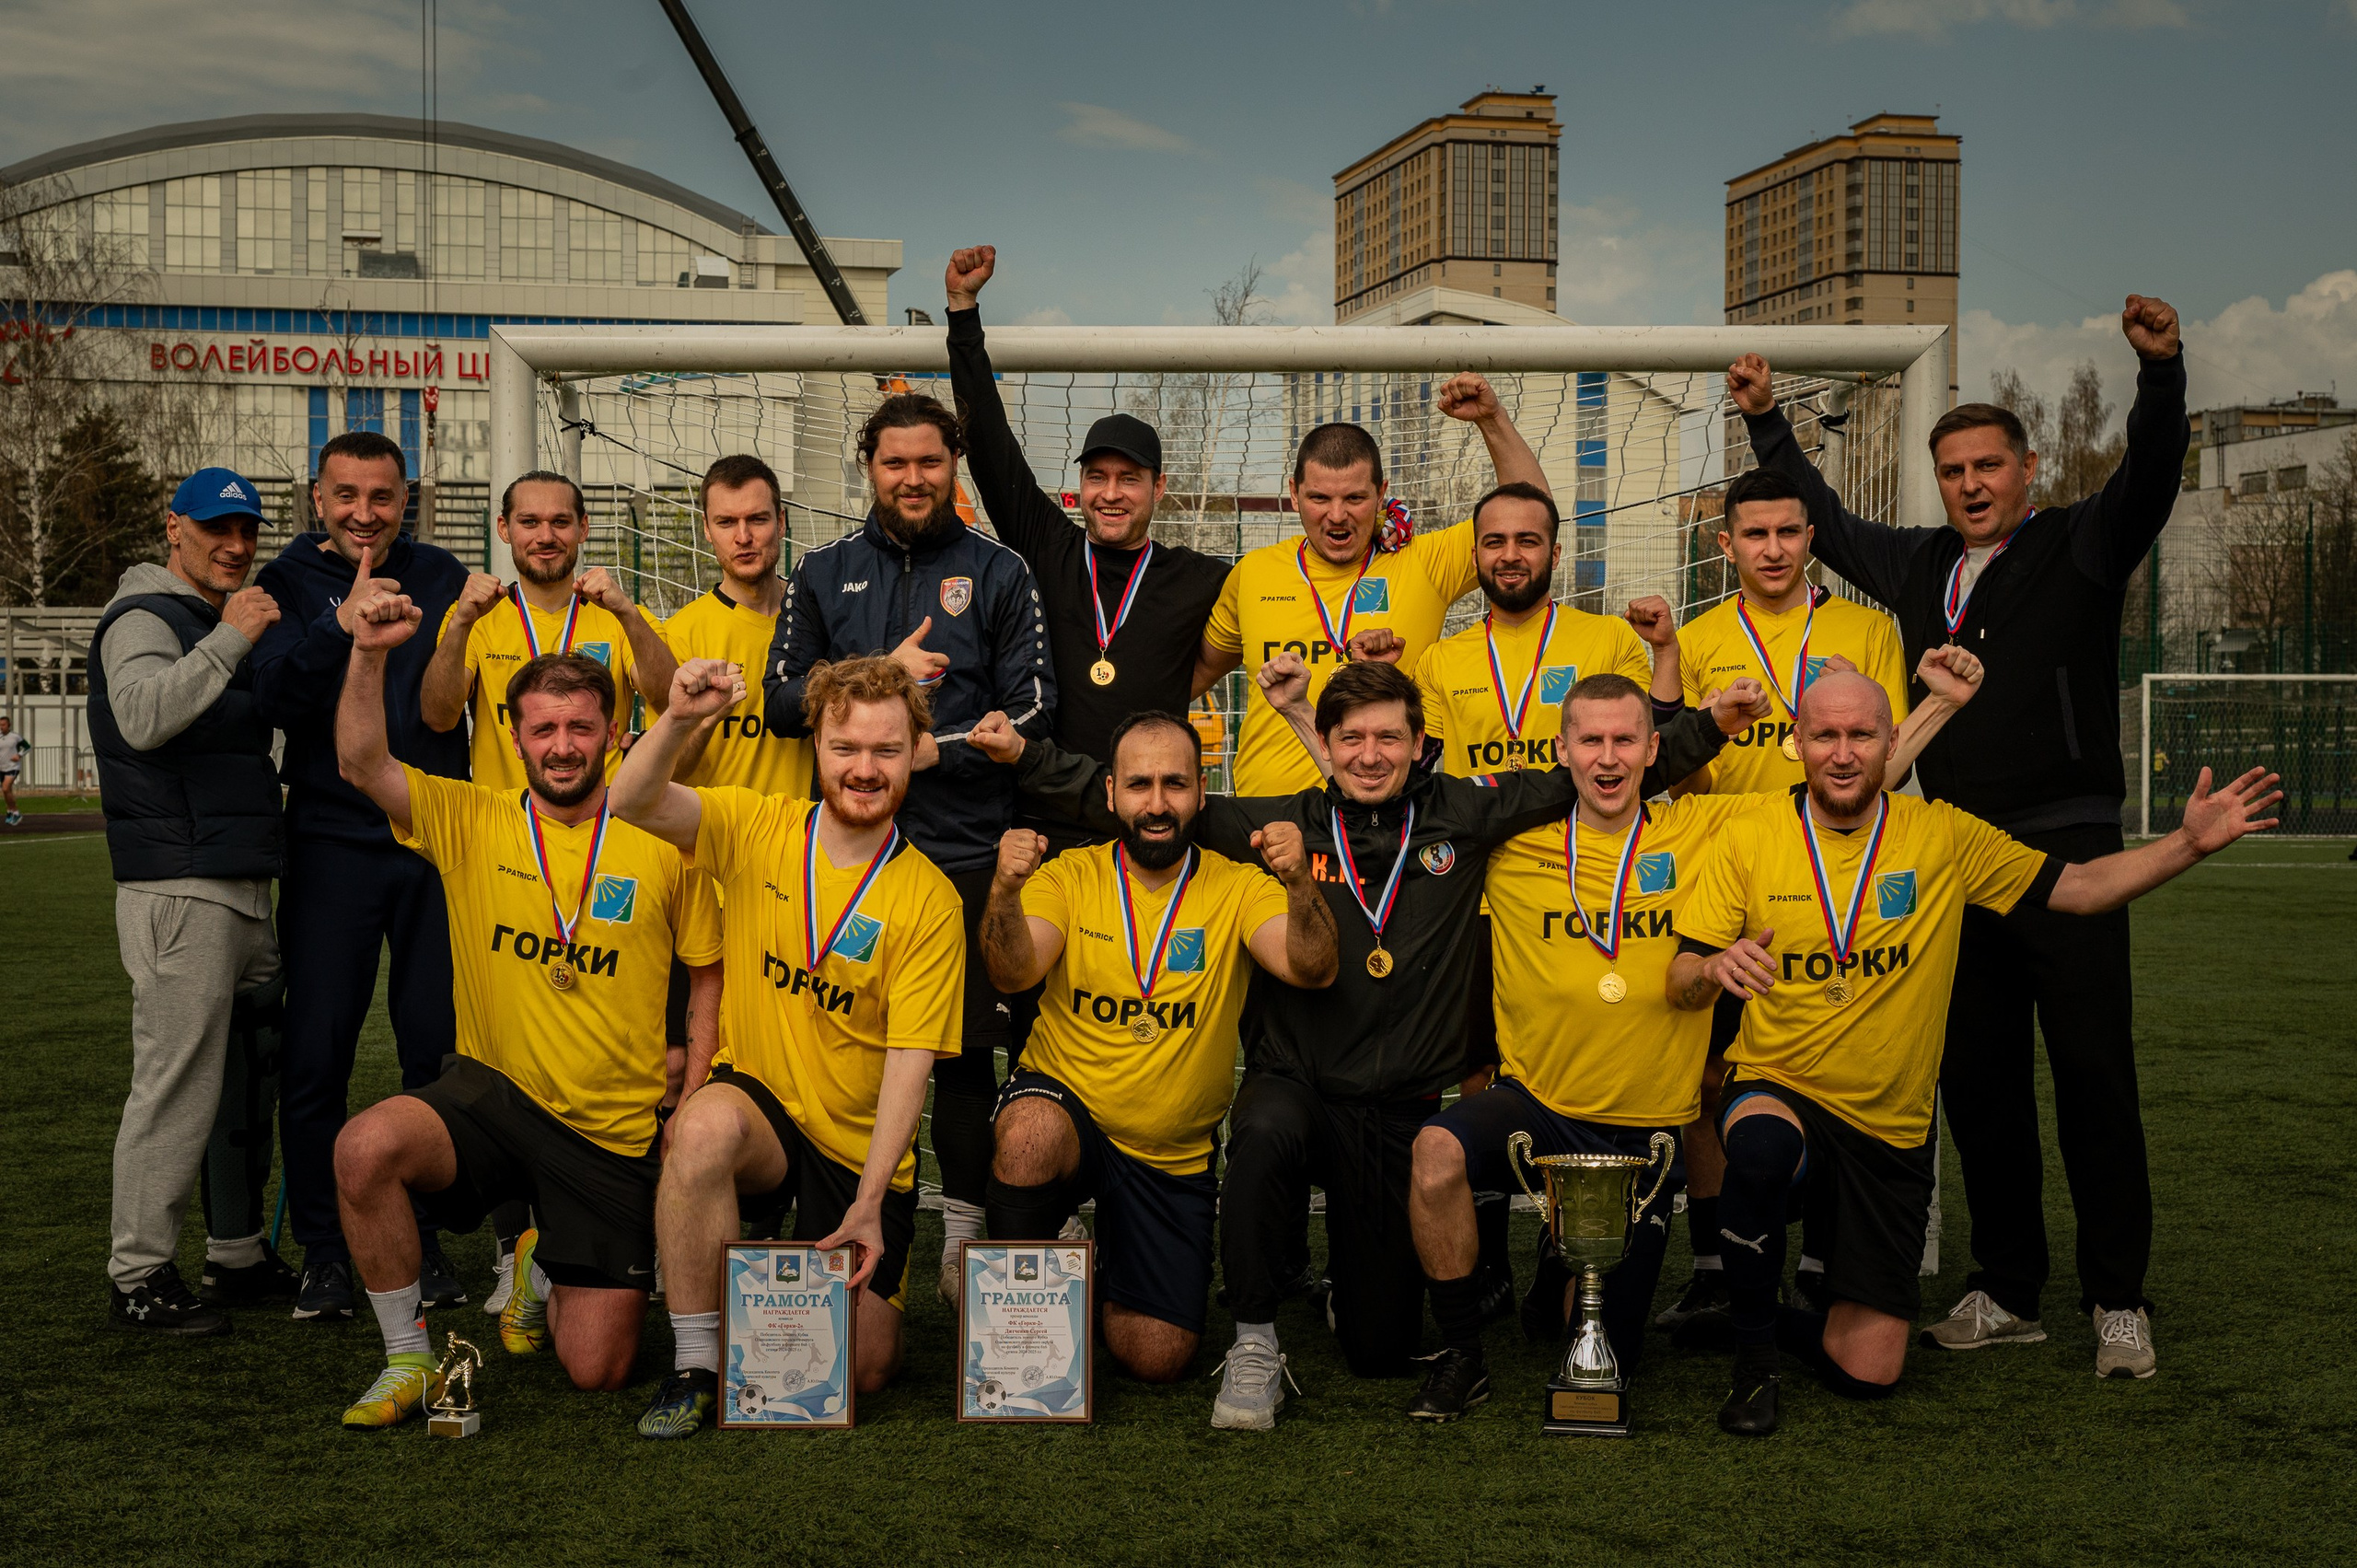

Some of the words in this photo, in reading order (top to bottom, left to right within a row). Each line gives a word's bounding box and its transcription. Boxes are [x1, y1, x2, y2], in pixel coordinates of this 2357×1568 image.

[150, 339, 443, 377] ВОЛЕЙБОЛЬНЫЙ
[219, 492, 248, 501] adidas
[842, 580, 868, 593] JAKO
[1717, 664, 1747, 672] PATRICK
[1460, 687, 1489, 696] PATRICK
[505, 867, 538, 882] PATRICK
[1777, 894, 1812, 902] PATRICK
[1543, 910, 1674, 939] ГОРКИ
[491, 923, 620, 977] ГОРКИ
[1782, 942, 1910, 981] ГОРКИ
[763, 950, 855, 1016] ГОРКИ
[1073, 988, 1196, 1029] ГОРКИ
[740, 1294, 834, 1307] ГРАМОТА
[981, 1292, 1071, 1305] ГРАМОТА
